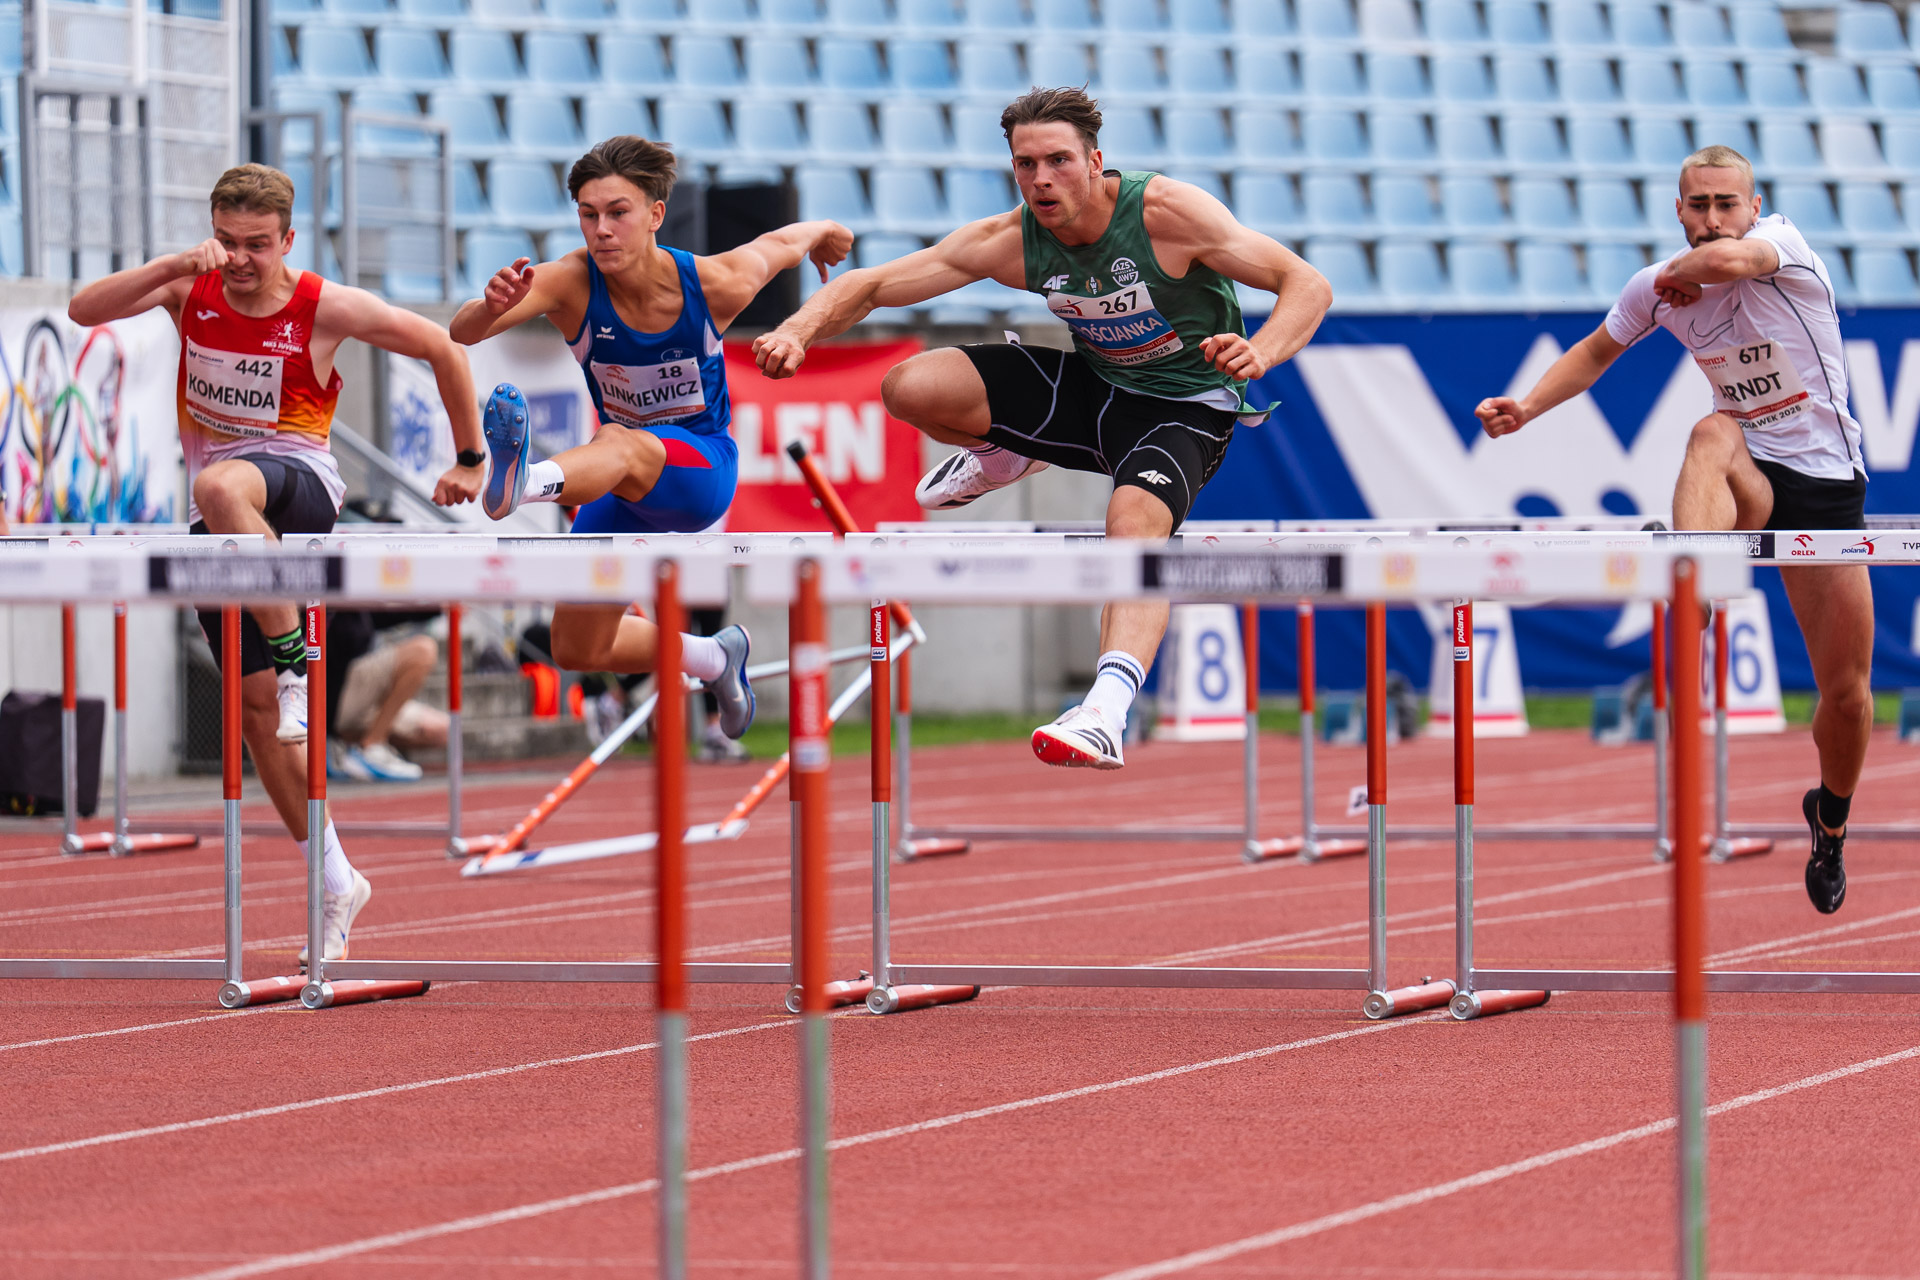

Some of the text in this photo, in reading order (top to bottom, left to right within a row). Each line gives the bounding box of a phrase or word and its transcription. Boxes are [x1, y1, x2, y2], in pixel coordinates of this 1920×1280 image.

[1115, 261, 1130, 271] AZS
[1118, 272, 1135, 283] AWF
[1042, 274, 1070, 290] 4F
[1099, 290, 1138, 315] 267
[1079, 316, 1164, 342] OŚCIANKA
[1147, 344, 1171, 358] 2025
[1739, 343, 1772, 365] 677
[235, 358, 273, 378] 442
[657, 365, 683, 380] 18
[188, 373, 276, 410] KOMENDA
[602, 380, 699, 407] LINKIEWICZ
[1718, 371, 1783, 403] ARNDT
[1739, 414, 1778, 429] OCŁAWEK
[1778, 405, 1802, 419] 2025
[243, 428, 265, 437] 2025
[734, 401, 885, 485] LEN
[1137, 469, 1172, 485] 4F
[1841, 547, 1868, 555] polanik
[1902, 542, 1920, 550] TVP
[308, 610, 317, 643] polanik
[873, 610, 884, 644] polanik
[1456, 609, 1467, 643] polanik
[1197, 629, 1230, 702] 8
[1731, 622, 1762, 695] 6
